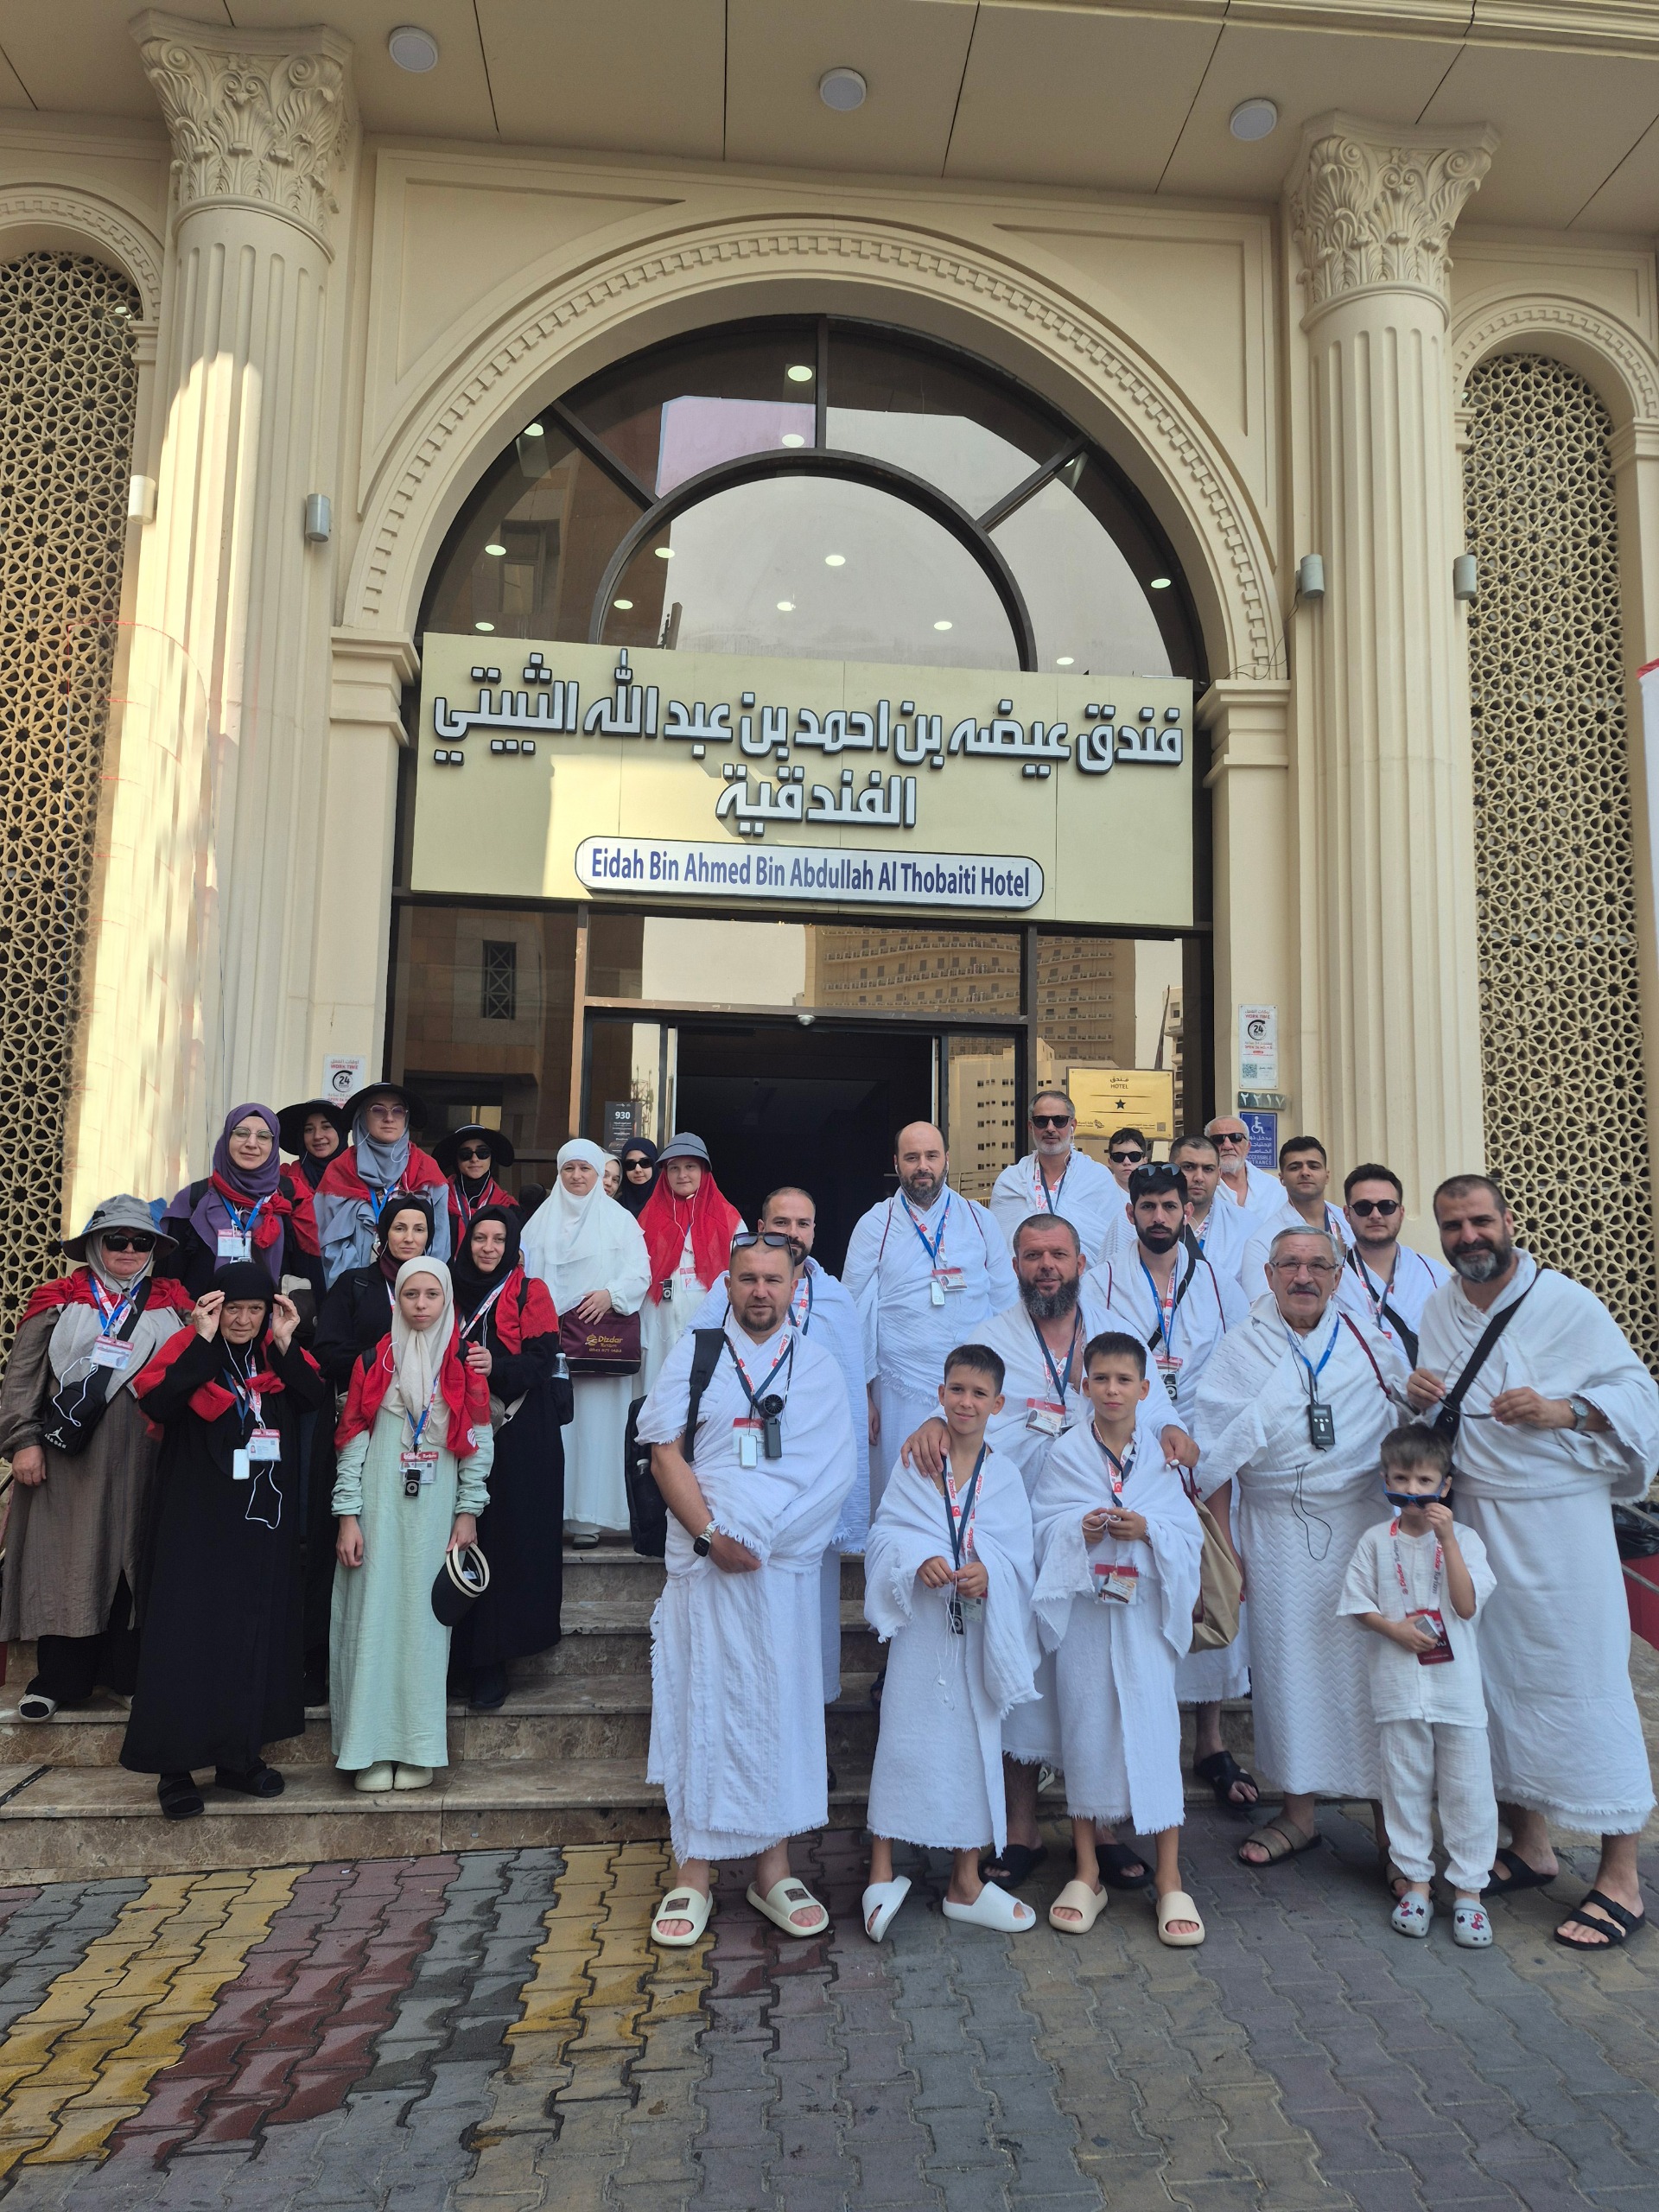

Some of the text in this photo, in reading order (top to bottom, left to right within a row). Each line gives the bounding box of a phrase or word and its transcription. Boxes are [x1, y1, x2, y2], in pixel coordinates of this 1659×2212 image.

[434, 648, 1184, 779] فندق عيضه بن احمد بن عبد الله الثبيتي
[715, 762, 918, 837] الفندقية
[592, 848, 1030, 897] Eidah Bin Ahmed Bin Abdullah Al Thobaiti Hotel
[1253, 1024, 1264, 1033] 24
[340, 1076, 350, 1084] 24
[614, 1111, 631, 1120] 930
[598, 1335, 624, 1344] Dizdar
[948, 1478, 957, 1500] Dizdar
[1397, 1563, 1407, 1587] Dizdar
[1432, 1571, 1441, 1594] Turizm
